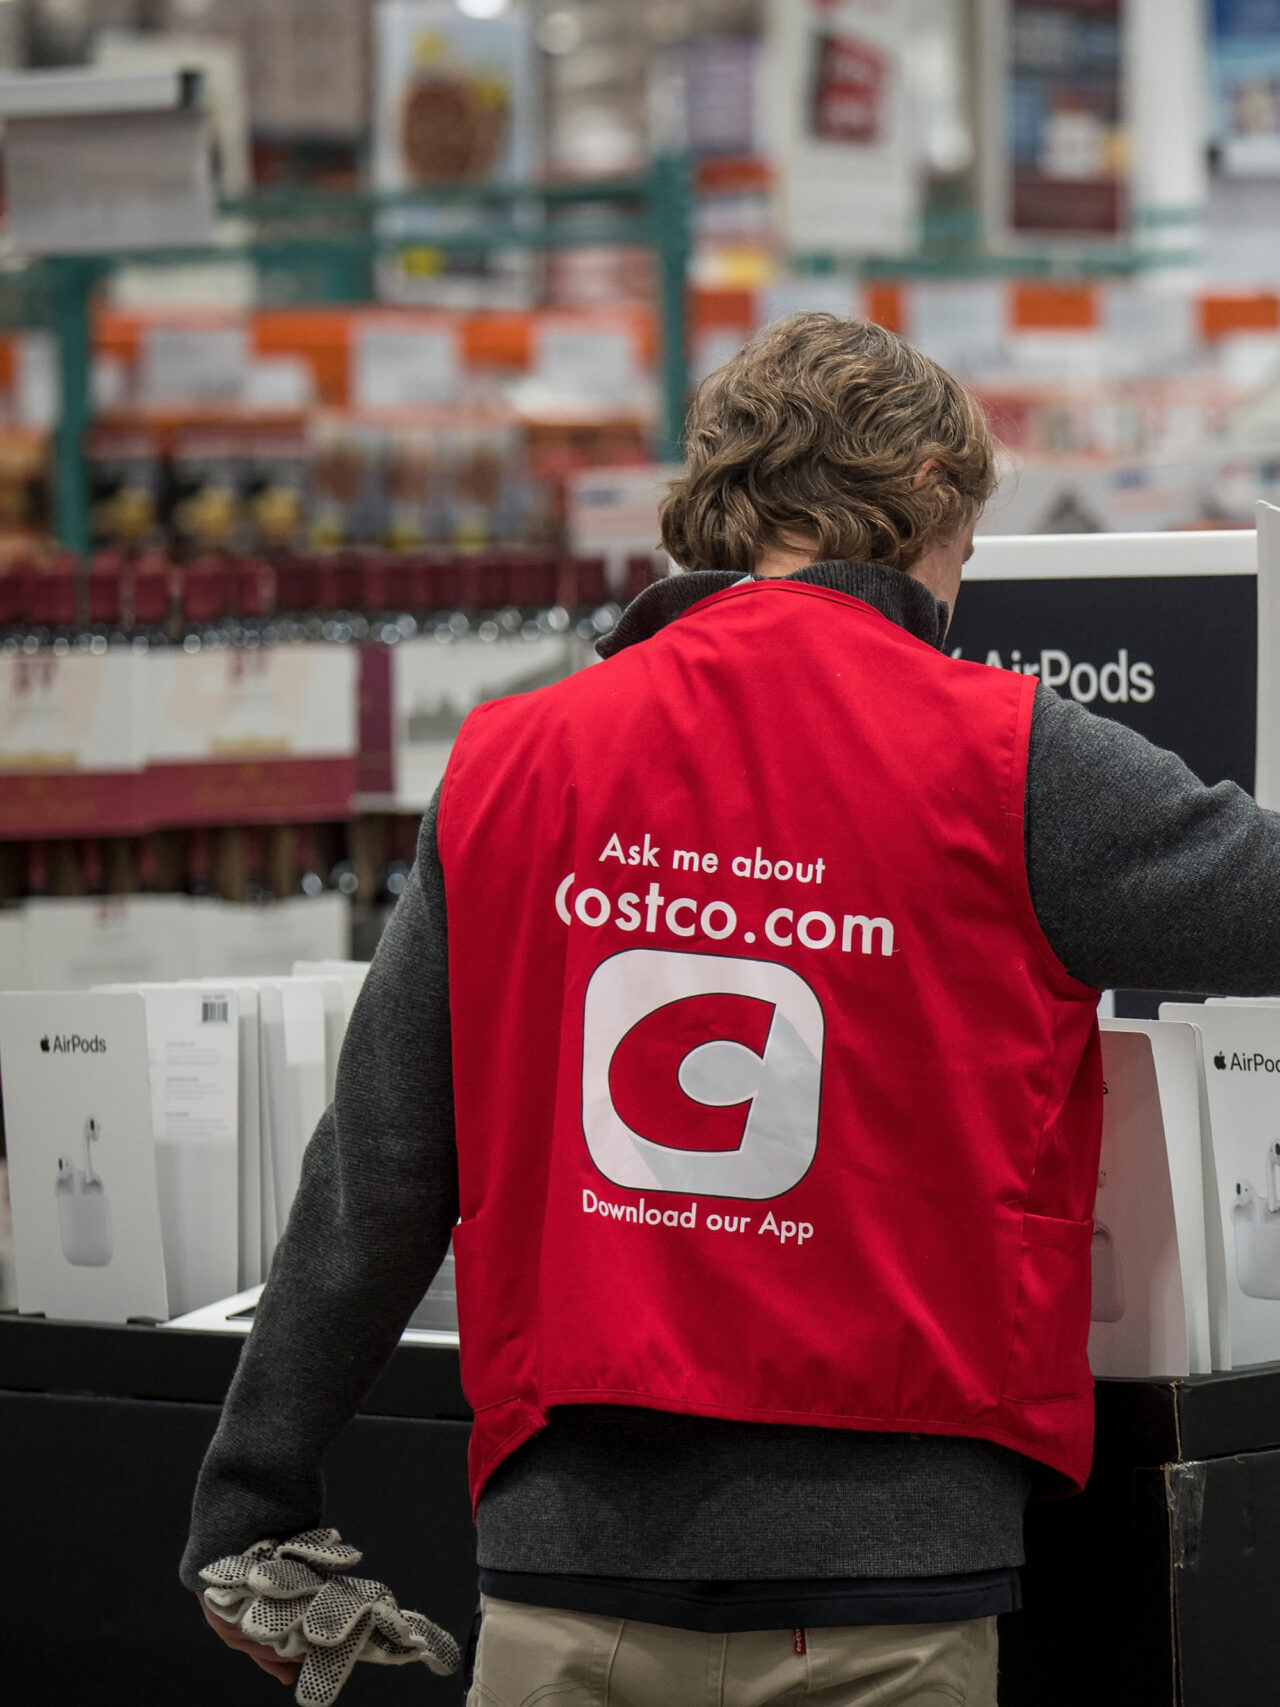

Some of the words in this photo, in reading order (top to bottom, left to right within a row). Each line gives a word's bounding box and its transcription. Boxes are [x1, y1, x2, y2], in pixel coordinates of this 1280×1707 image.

[598, 832, 660, 867] Ask
[672, 849, 719, 873] me
[731, 847, 826, 883] about
[53, 1034, 107, 1053] AirPods
[582, 1189, 698, 1229] Download
[706, 1213, 751, 1233] our
[757, 1211, 814, 1246] App
